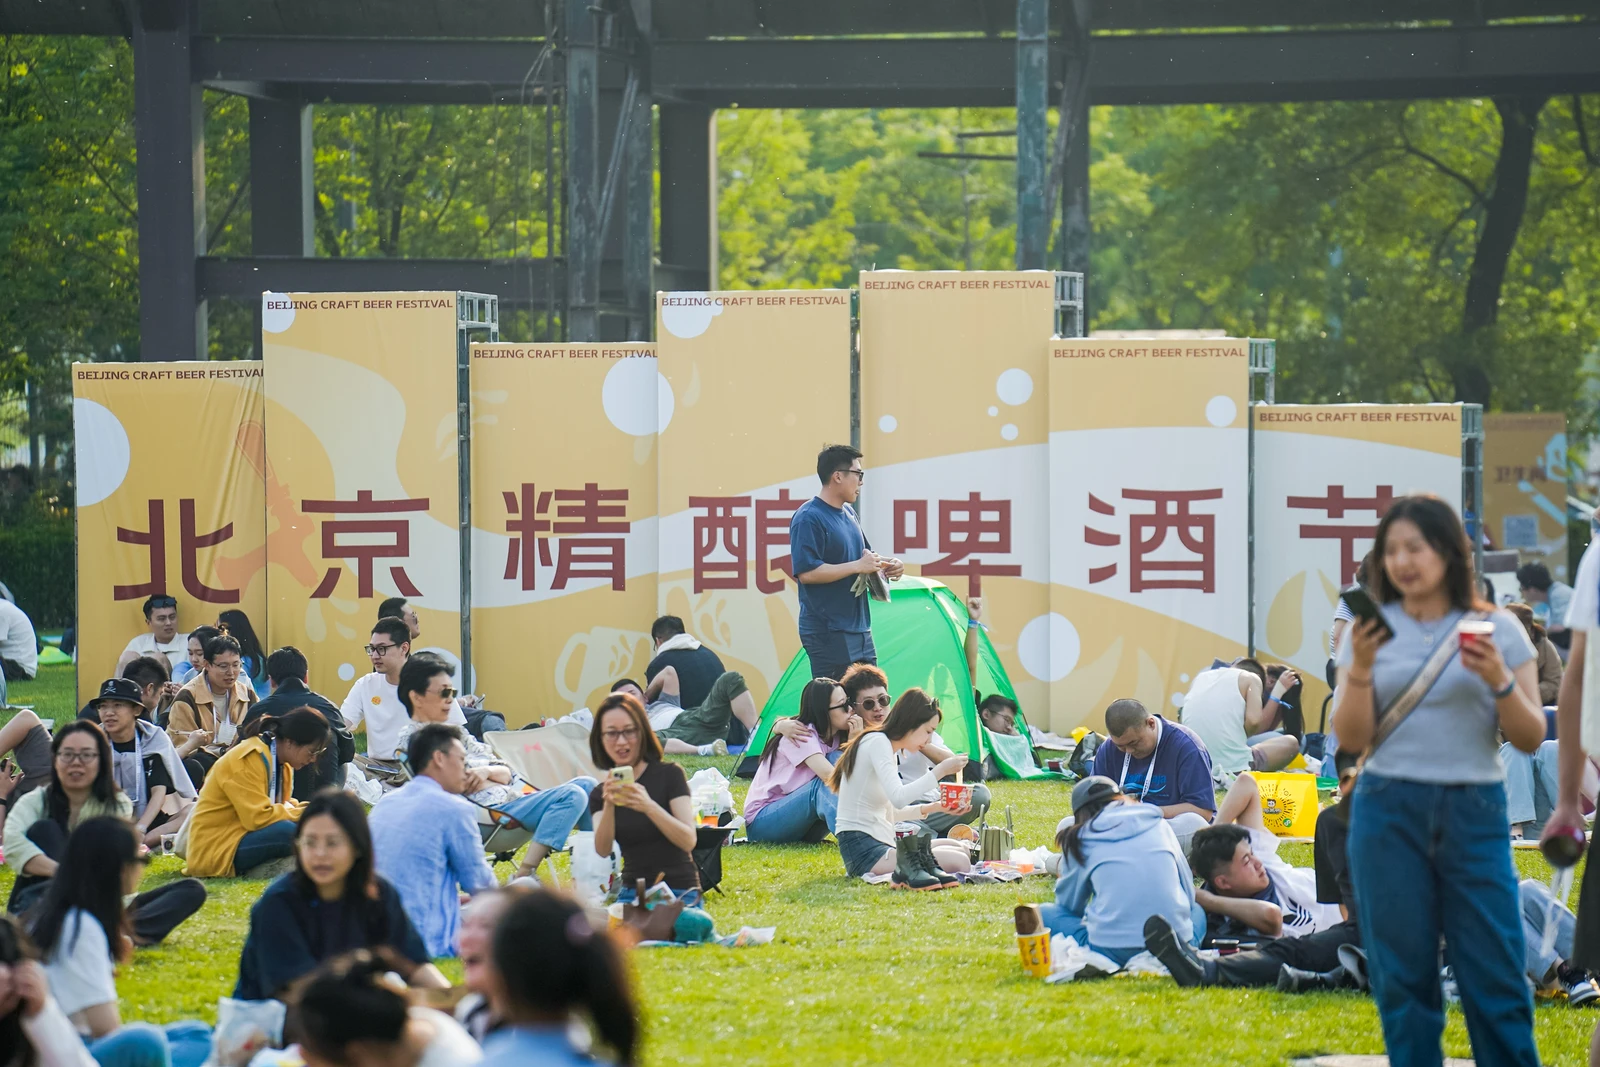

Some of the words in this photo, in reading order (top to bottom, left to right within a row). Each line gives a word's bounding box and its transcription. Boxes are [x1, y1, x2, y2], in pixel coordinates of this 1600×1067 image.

[864, 280, 915, 290] BEIJING
[918, 280, 957, 290] CRAFT
[960, 280, 990, 290] BEER
[993, 280, 1051, 289] FESTIVAL
[267, 300, 318, 310] BEIJING
[320, 299, 361, 310] CRAFT
[363, 299, 393, 309] BEER
[396, 298, 454, 309] FESTIVAL
[661, 297, 712, 307] BEIJING
[714, 297, 754, 307] CRAFT
[756, 297, 786, 306] BEER
[789, 296, 847, 306] FESTIVAL
[474, 349, 525, 359] BEIJING
[527, 349, 566, 359] CRAFT
[569, 349, 599, 358] BEER
[601, 349, 658, 358] FESTIVAL
[1054, 348, 1106, 358] BEIJING
[1108, 348, 1149, 358] CRAFT
[1151, 348, 1182, 358] BEER
[1185, 347, 1246, 358] FESTIVAL
[77, 370, 130, 381] BEIJING
[132, 370, 172, 380] CRAFT
[175, 370, 206, 380] BEER
[1259, 412, 1313, 423] BEIJING
[1316, 412, 1357, 422] CRAFT
[1360, 412, 1392, 422] BEER
[1395, 412, 1457, 422] FESTIVAL
